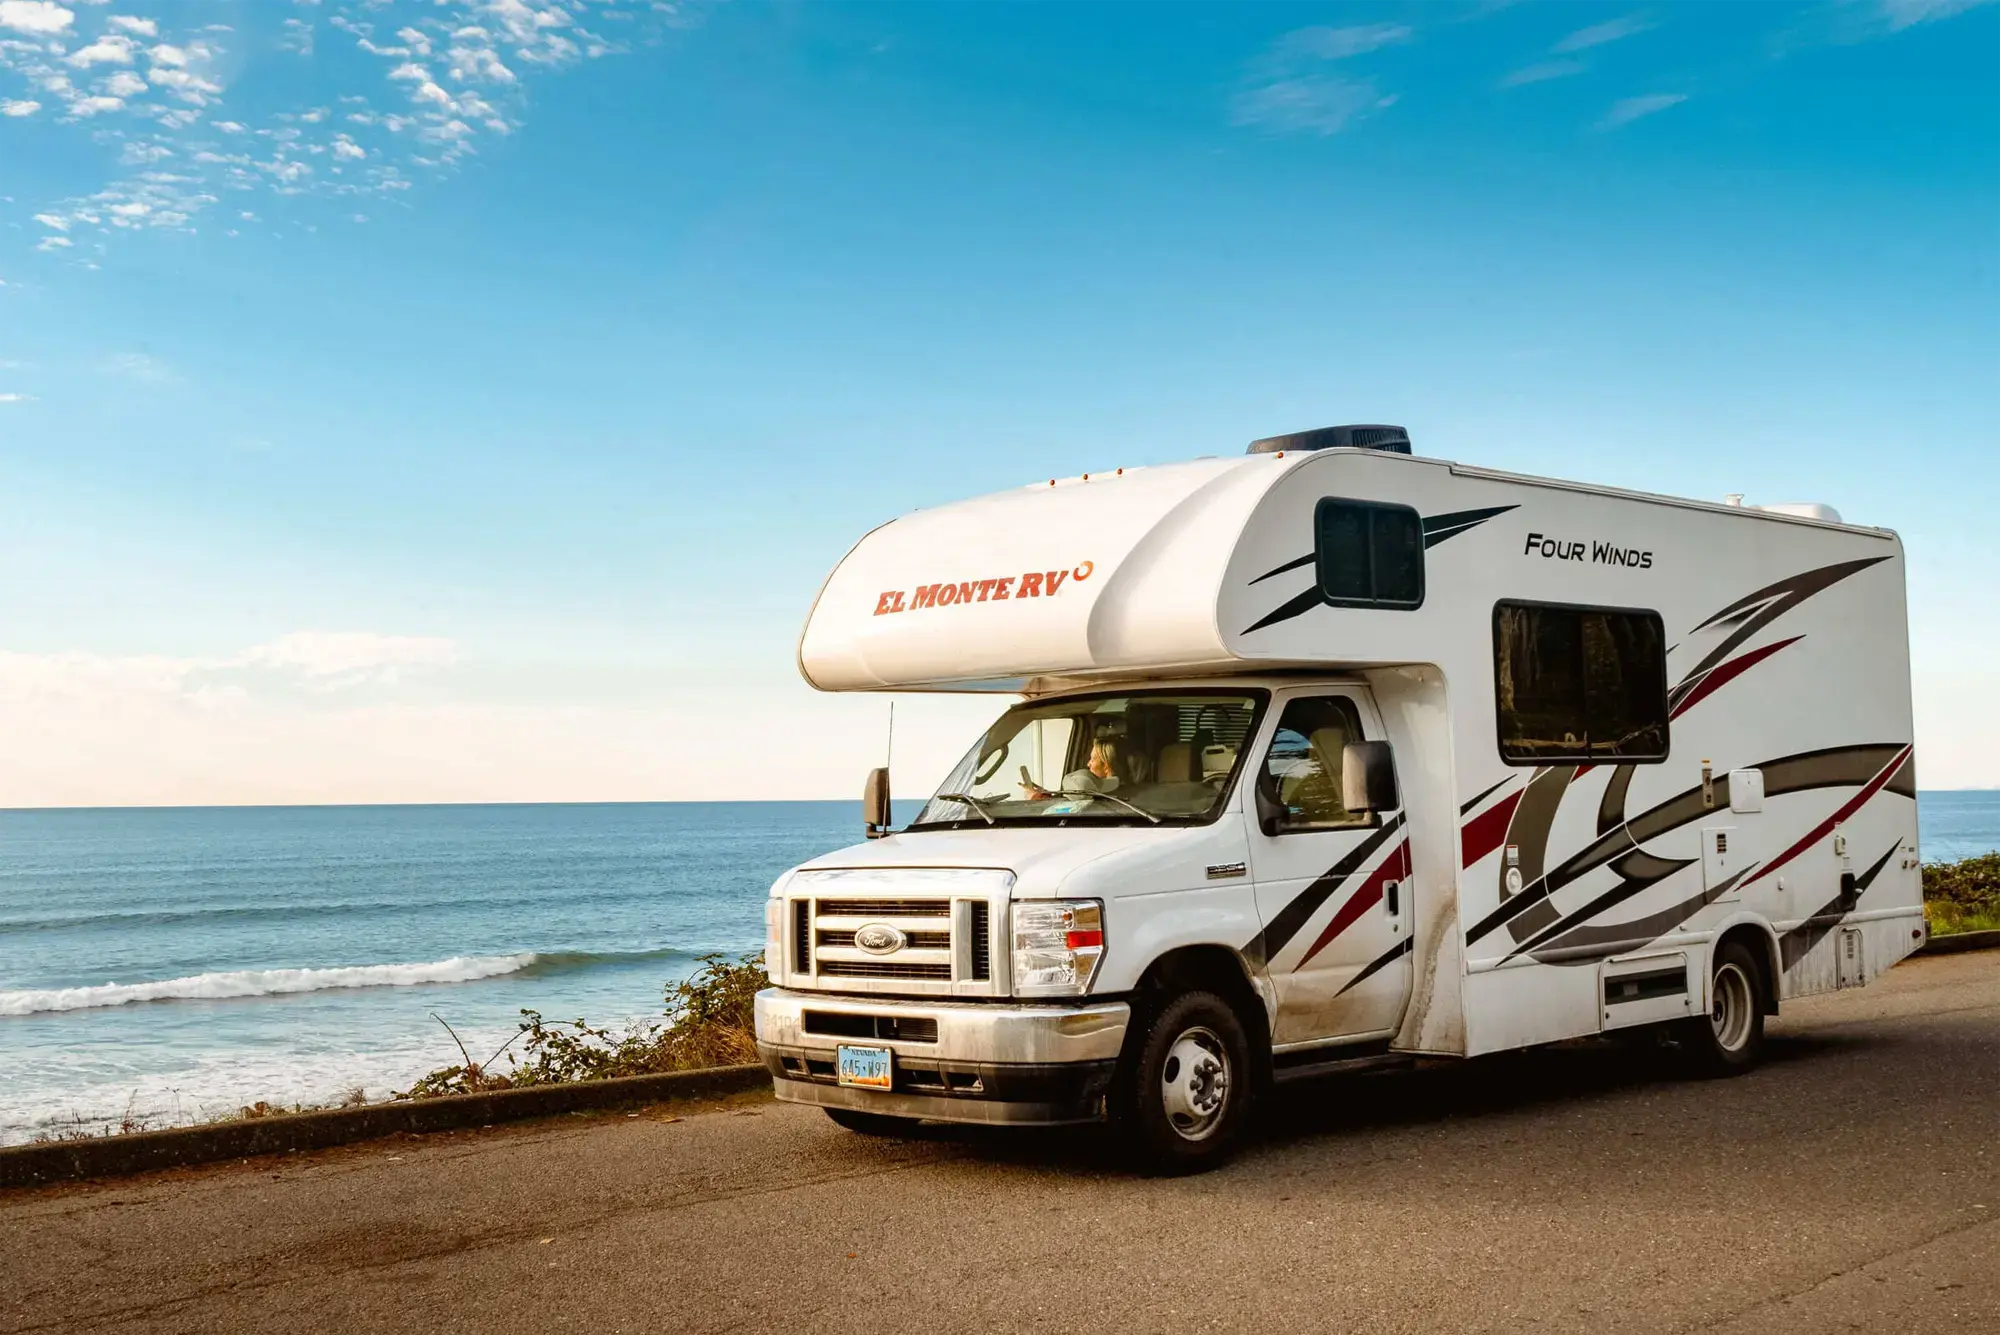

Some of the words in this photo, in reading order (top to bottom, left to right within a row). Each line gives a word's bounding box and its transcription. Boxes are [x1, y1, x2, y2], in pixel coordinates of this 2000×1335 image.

[1524, 532, 1586, 562] FOUR
[1592, 540, 1653, 569] WINDS
[873, 590, 906, 616] EL
[909, 577, 1016, 611] MONTE
[1016, 570, 1069, 599] RV
[864, 931, 887, 947] Ford
[851, 1049, 877, 1057] NEVADA
